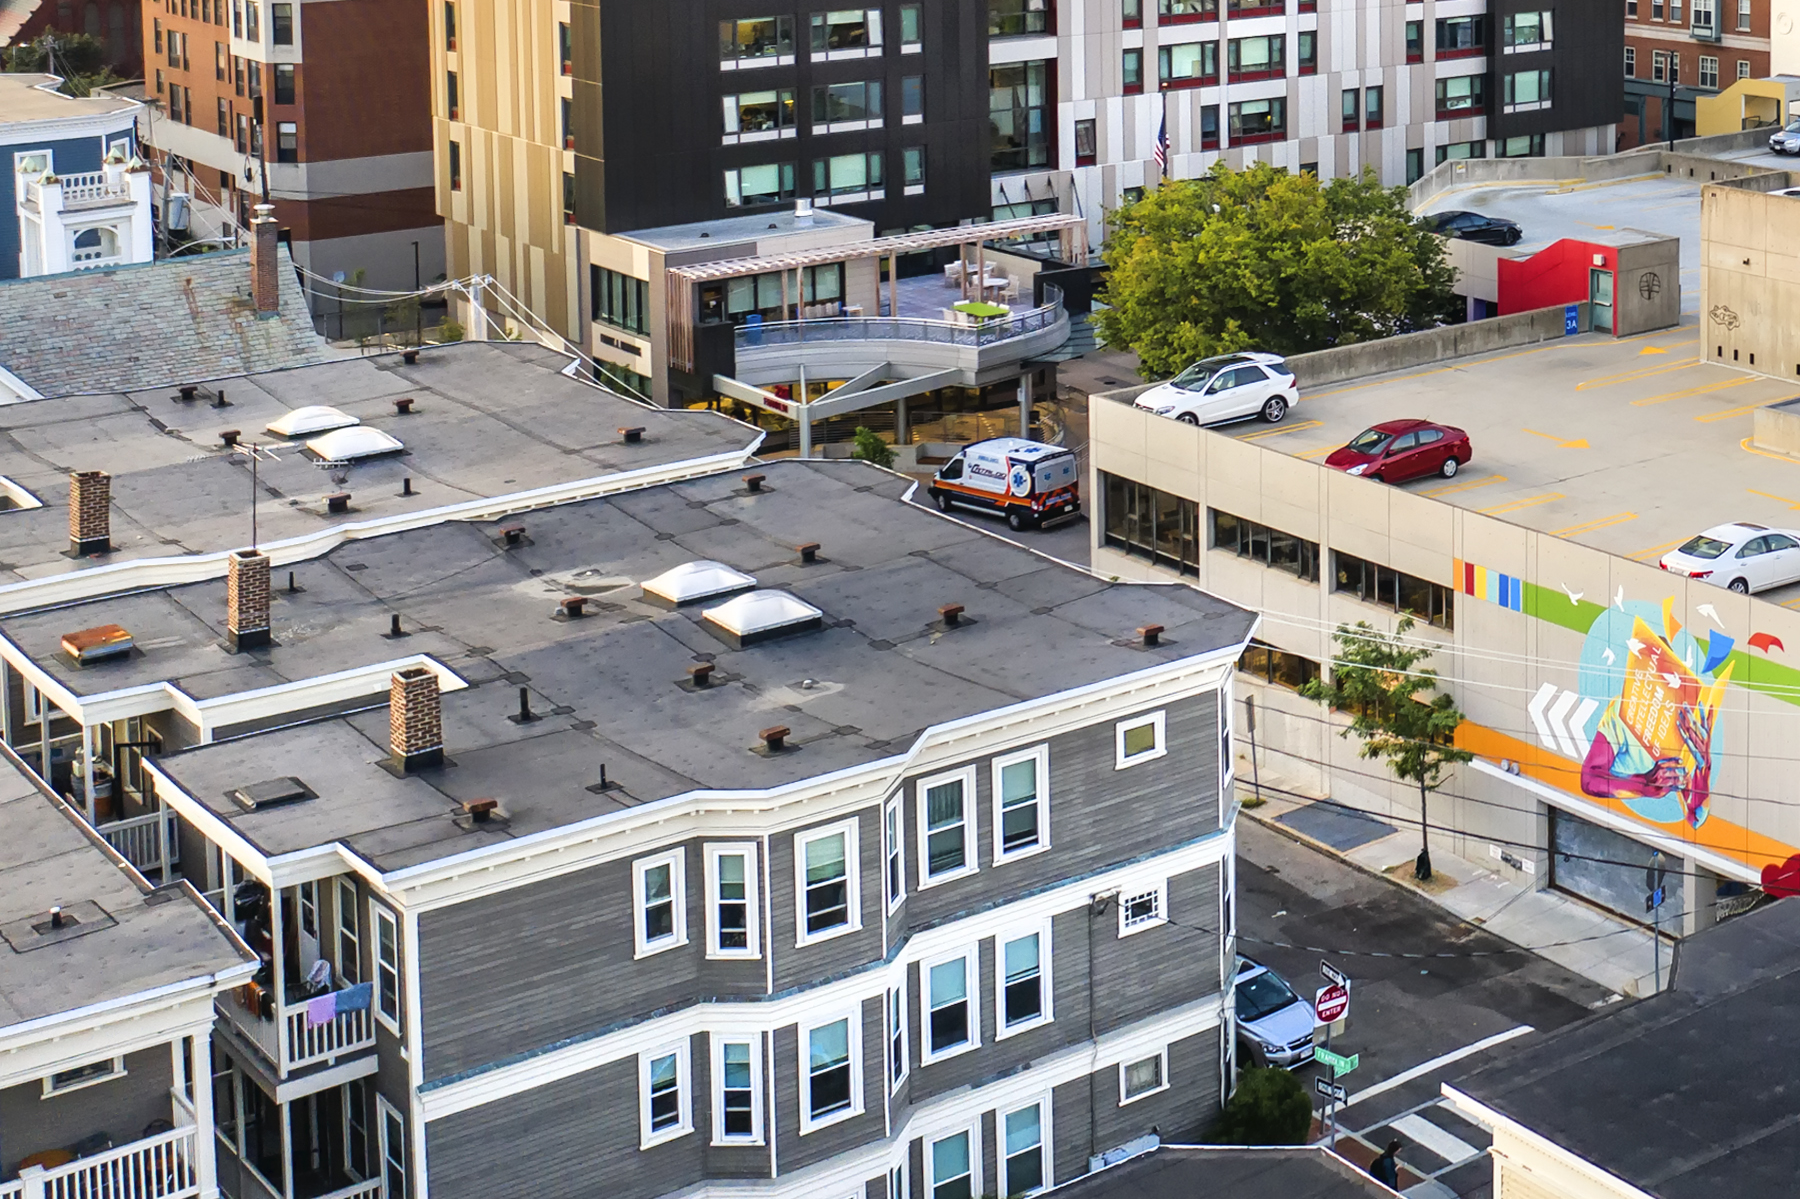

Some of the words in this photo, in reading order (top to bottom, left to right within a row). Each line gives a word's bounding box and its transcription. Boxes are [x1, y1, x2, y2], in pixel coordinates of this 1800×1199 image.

[1566, 320, 1578, 330] 3A
[1626, 669, 1644, 726] CREATIVE
[1634, 647, 1662, 736] INTELLECTUAL
[1642, 685, 1665, 747] FREEDOM
[1652, 739, 1661, 757] OF
[1657, 699, 1676, 740] IDEAS
[1322, 1005, 1342, 1018] ENTER
